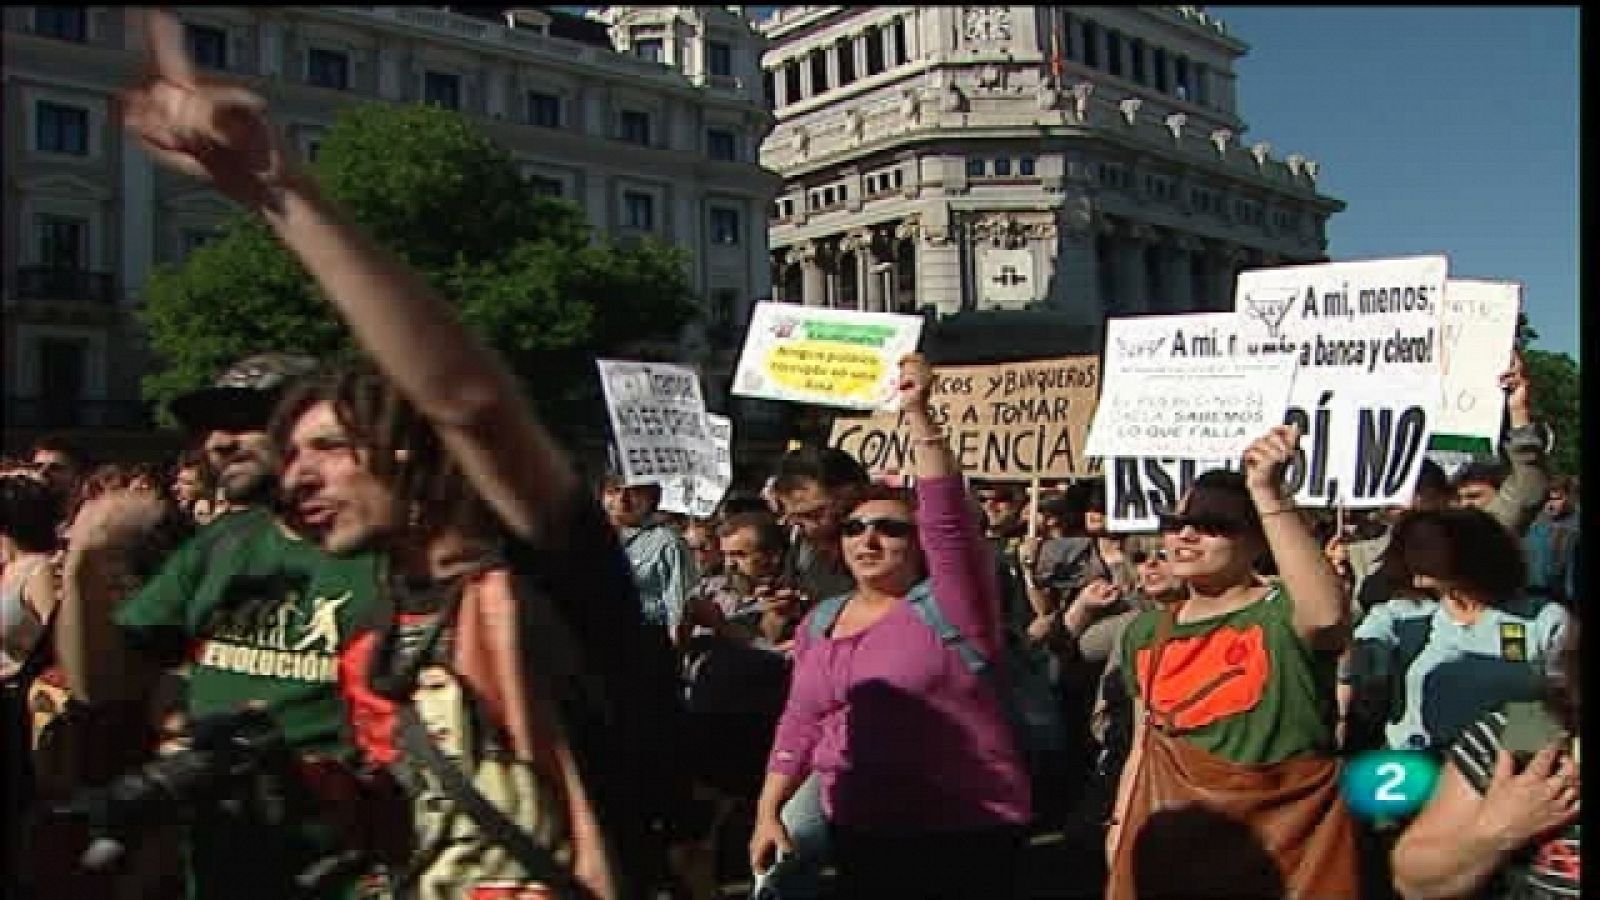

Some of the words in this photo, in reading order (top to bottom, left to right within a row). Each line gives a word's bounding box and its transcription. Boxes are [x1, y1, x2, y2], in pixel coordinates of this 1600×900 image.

[1302, 285, 1319, 319] A
[1170, 328, 1188, 357] A
[1315, 333, 1366, 366] banca
[1367, 338, 1381, 373] y
[961, 404, 979, 424] A
[990, 397, 1069, 426] TOMAR
[838, 423, 1075, 474] CONENCIA
[1352, 404, 1426, 498] NO
